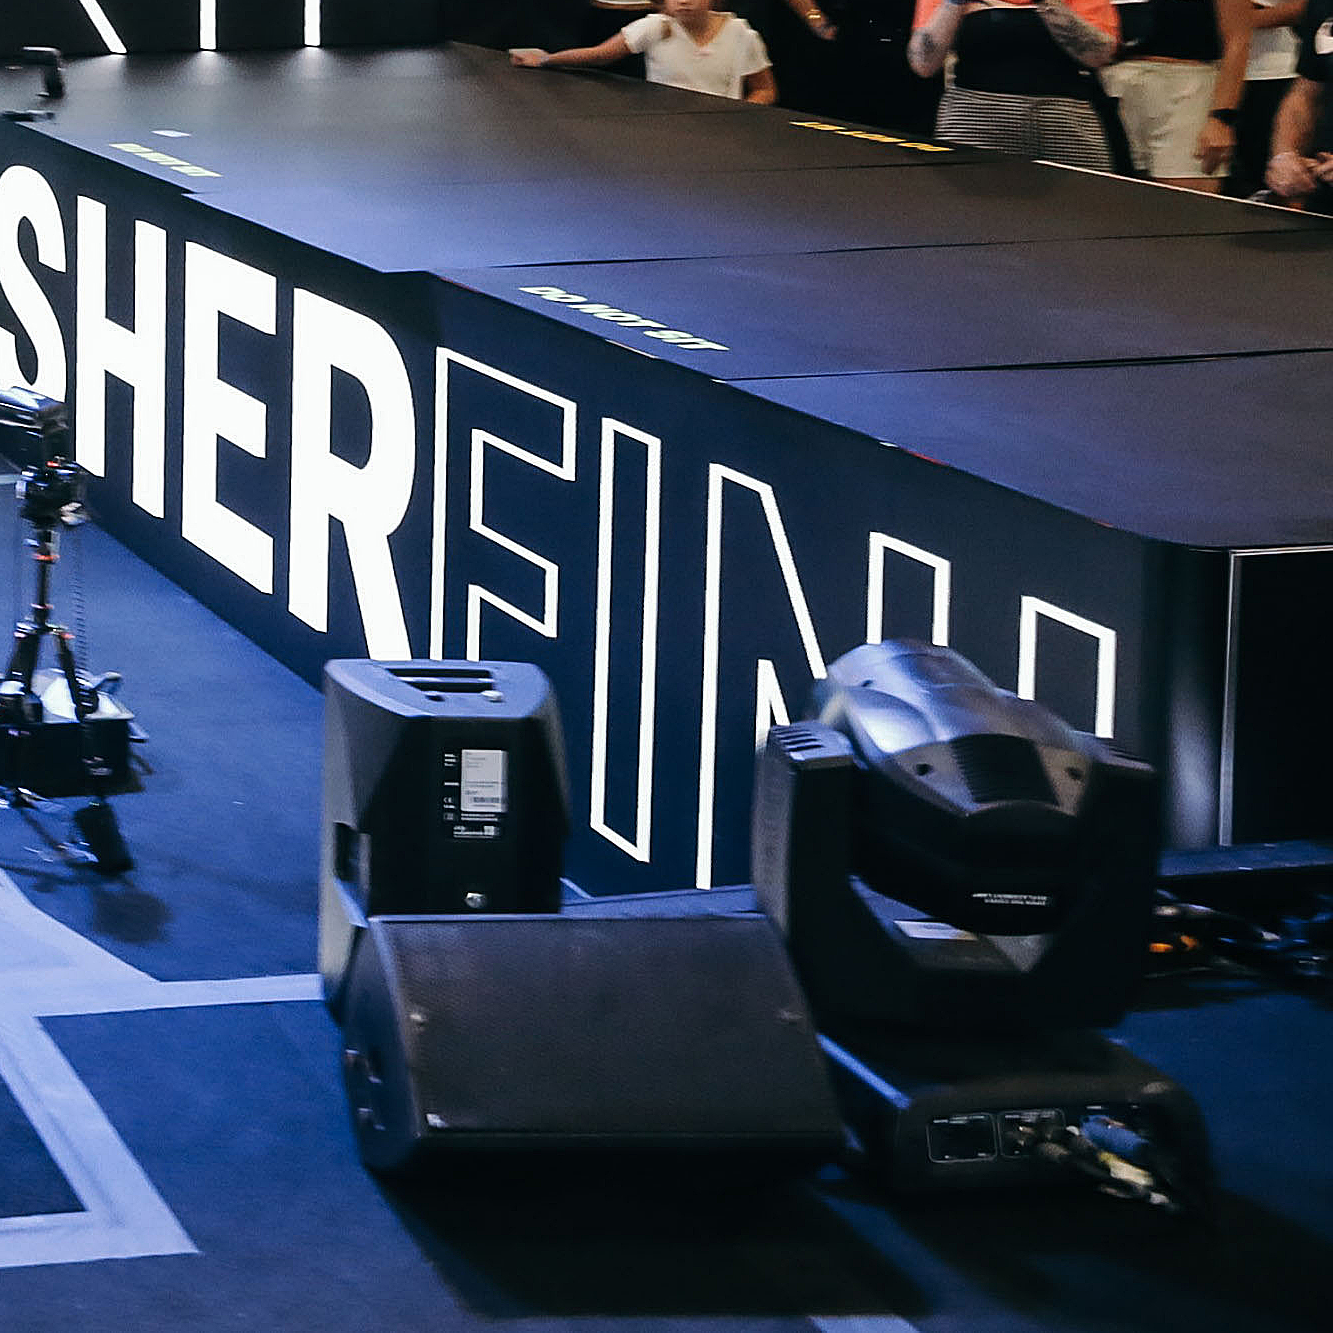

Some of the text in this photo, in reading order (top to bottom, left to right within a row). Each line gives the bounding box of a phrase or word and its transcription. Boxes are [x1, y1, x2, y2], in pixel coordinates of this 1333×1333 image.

[518, 286, 730, 351] DO NOT SIT
